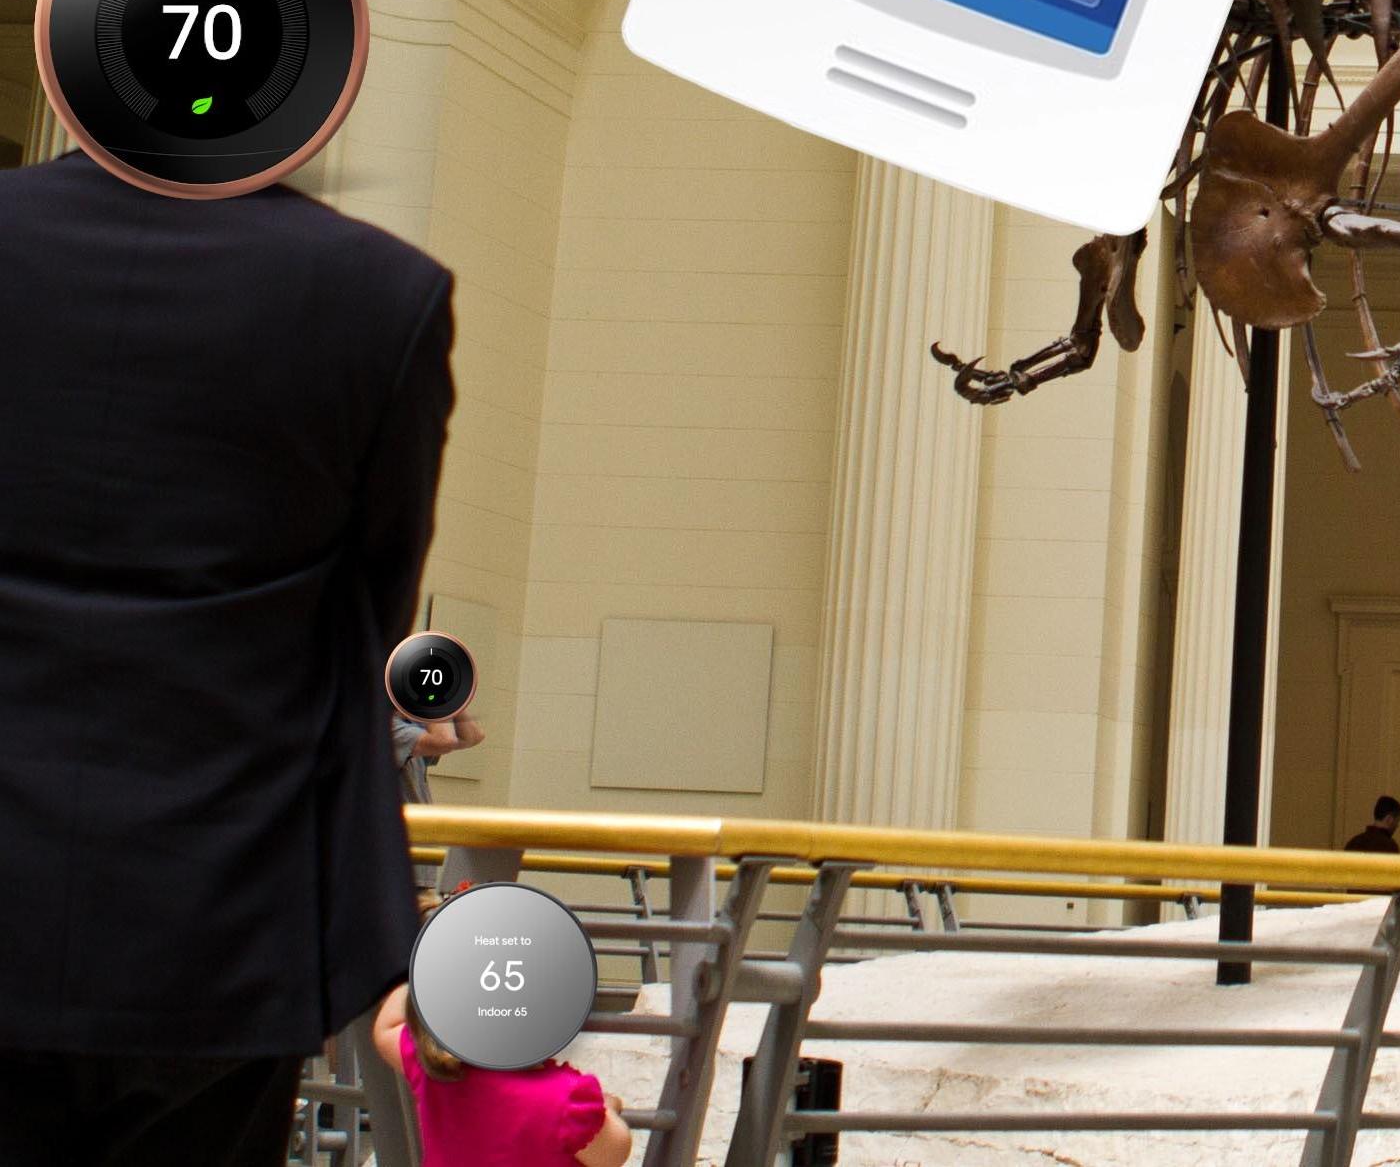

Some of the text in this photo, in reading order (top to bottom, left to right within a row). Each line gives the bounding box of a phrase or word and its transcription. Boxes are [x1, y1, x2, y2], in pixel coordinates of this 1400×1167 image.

[163, 4, 242, 61] 70
[420, 669, 443, 686] 70
[474, 936, 532, 946] Heat set to
[480, 960, 525, 992] 65
[477, 1006, 528, 1017] Indoor 65
